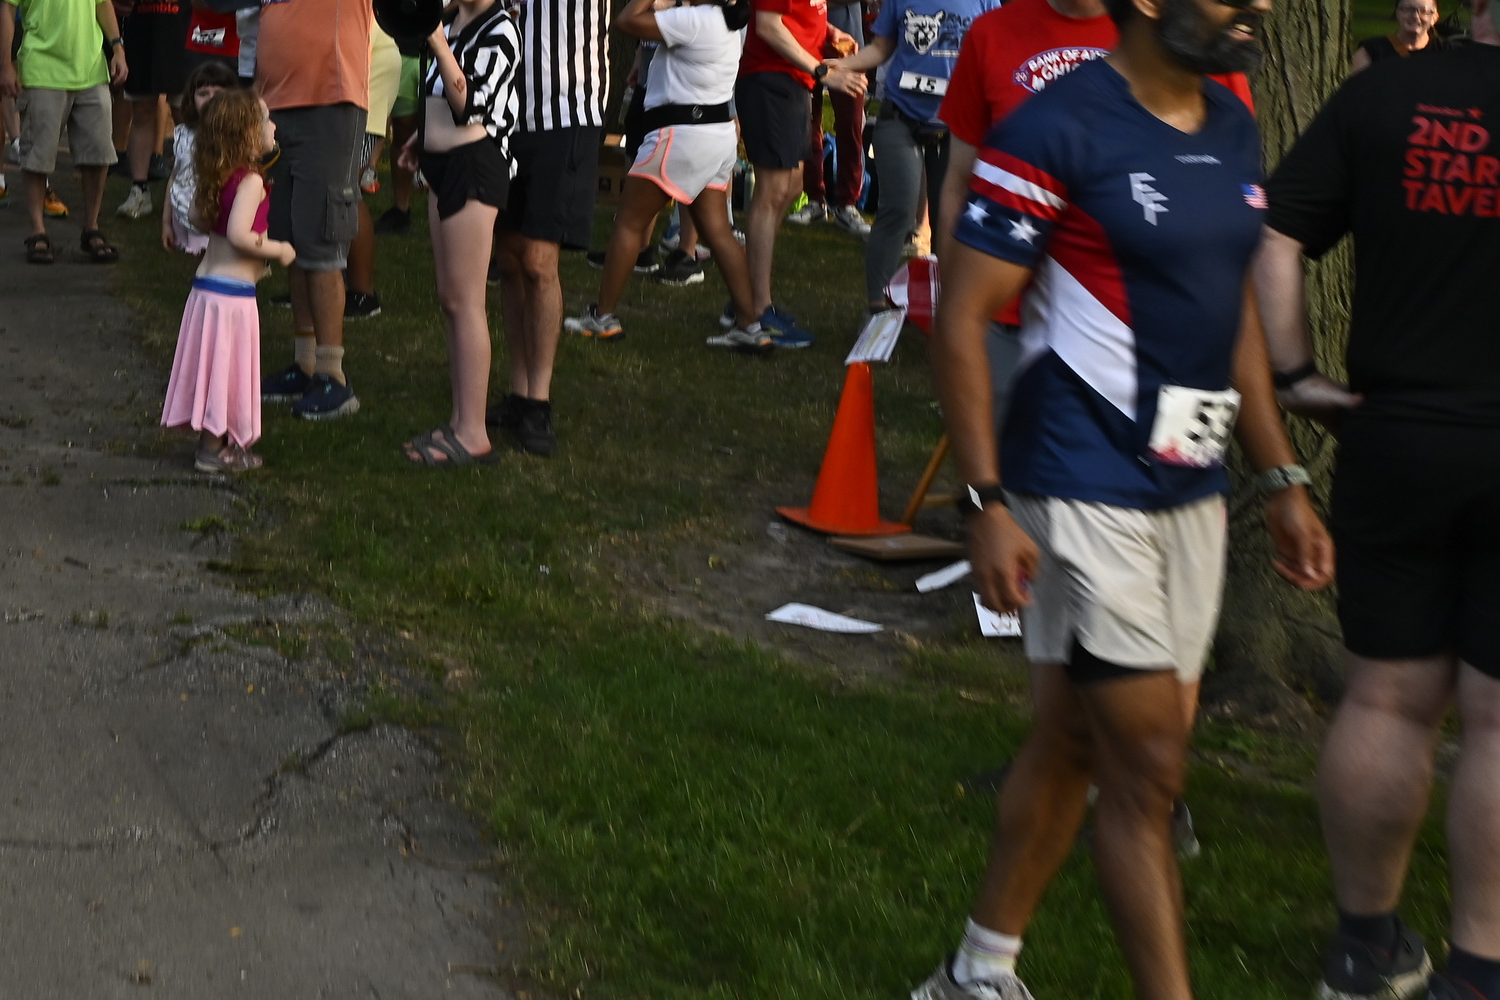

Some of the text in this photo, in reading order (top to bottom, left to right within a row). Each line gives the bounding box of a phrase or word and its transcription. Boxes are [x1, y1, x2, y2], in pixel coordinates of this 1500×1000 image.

[1027, 50, 1061, 72] BANK
[1061, 49, 1081, 62] OF
[914, 75, 937, 94] 15
[1407, 115, 1491, 153] 2ND
[1401, 179, 1500, 218] TAVE
